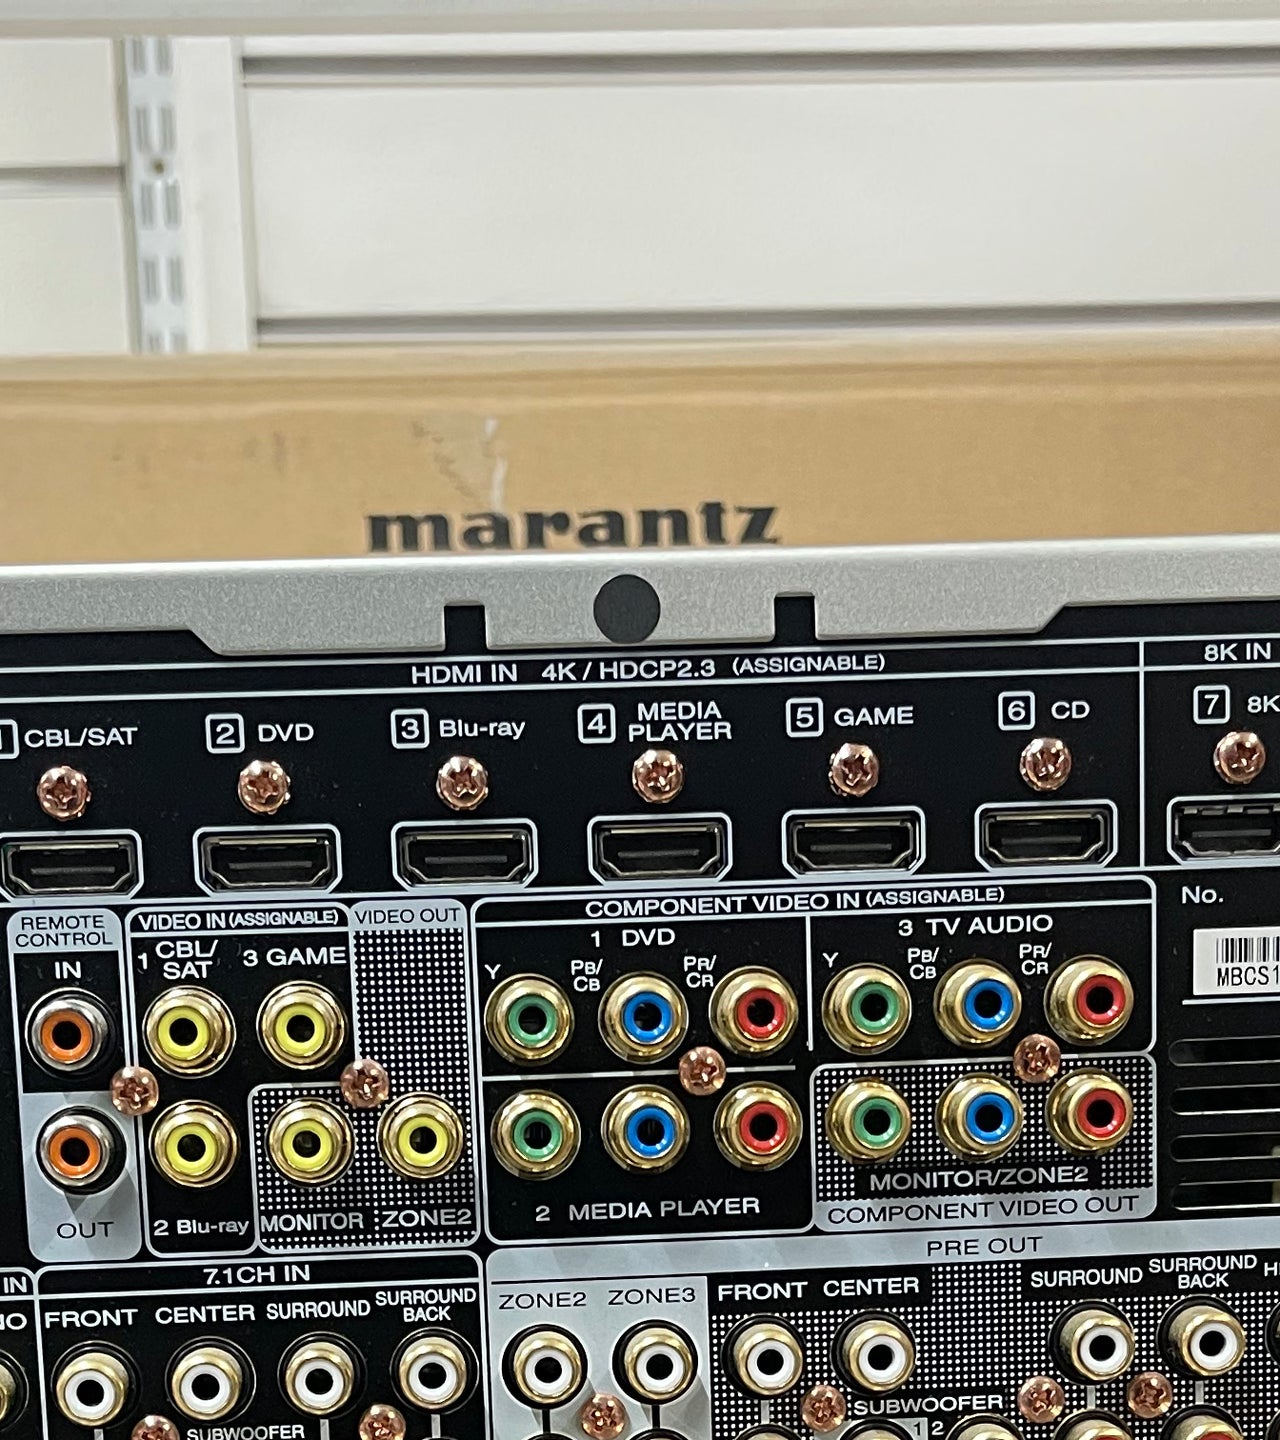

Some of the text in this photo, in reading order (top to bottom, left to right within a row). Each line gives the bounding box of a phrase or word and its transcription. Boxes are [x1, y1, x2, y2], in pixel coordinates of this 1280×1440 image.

[365, 501, 783, 552] marantz
[412, 653, 886, 685] HDMI IN 4K HDCP2.3 (ASSIGNABLE)
[585, 887, 1005, 917] COMPONENT VIDEO IN (ASSIGNABLE)
[1181, 886, 1224, 904] No.
[20, 914, 104, 930] REMOTE
[138, 909, 338, 931] VIDEO IN (ASSIGNABLE)
[15, 931, 113, 947] CONTROL
[870, 1166, 1089, 1191] MONITOR/ZONE2
[828, 1195, 1139, 1223] COMPONENT VIDEO OUT
[928, 1235, 1043, 1256] PRE OUT
[1148, 1255, 1258, 1274] SURROUND
[203, 1265, 310, 1285] 7.1CH IN
[1031, 1267, 1142, 1288] SURROUND
[1177, 1271, 1229, 1289] BACK
[608, 1287, 696, 1306] ZONE3
[718, 1282, 808, 1301] FRONT
[823, 1277, 919, 1297] CENTER
[499, 1291, 587, 1310] ZONE2
